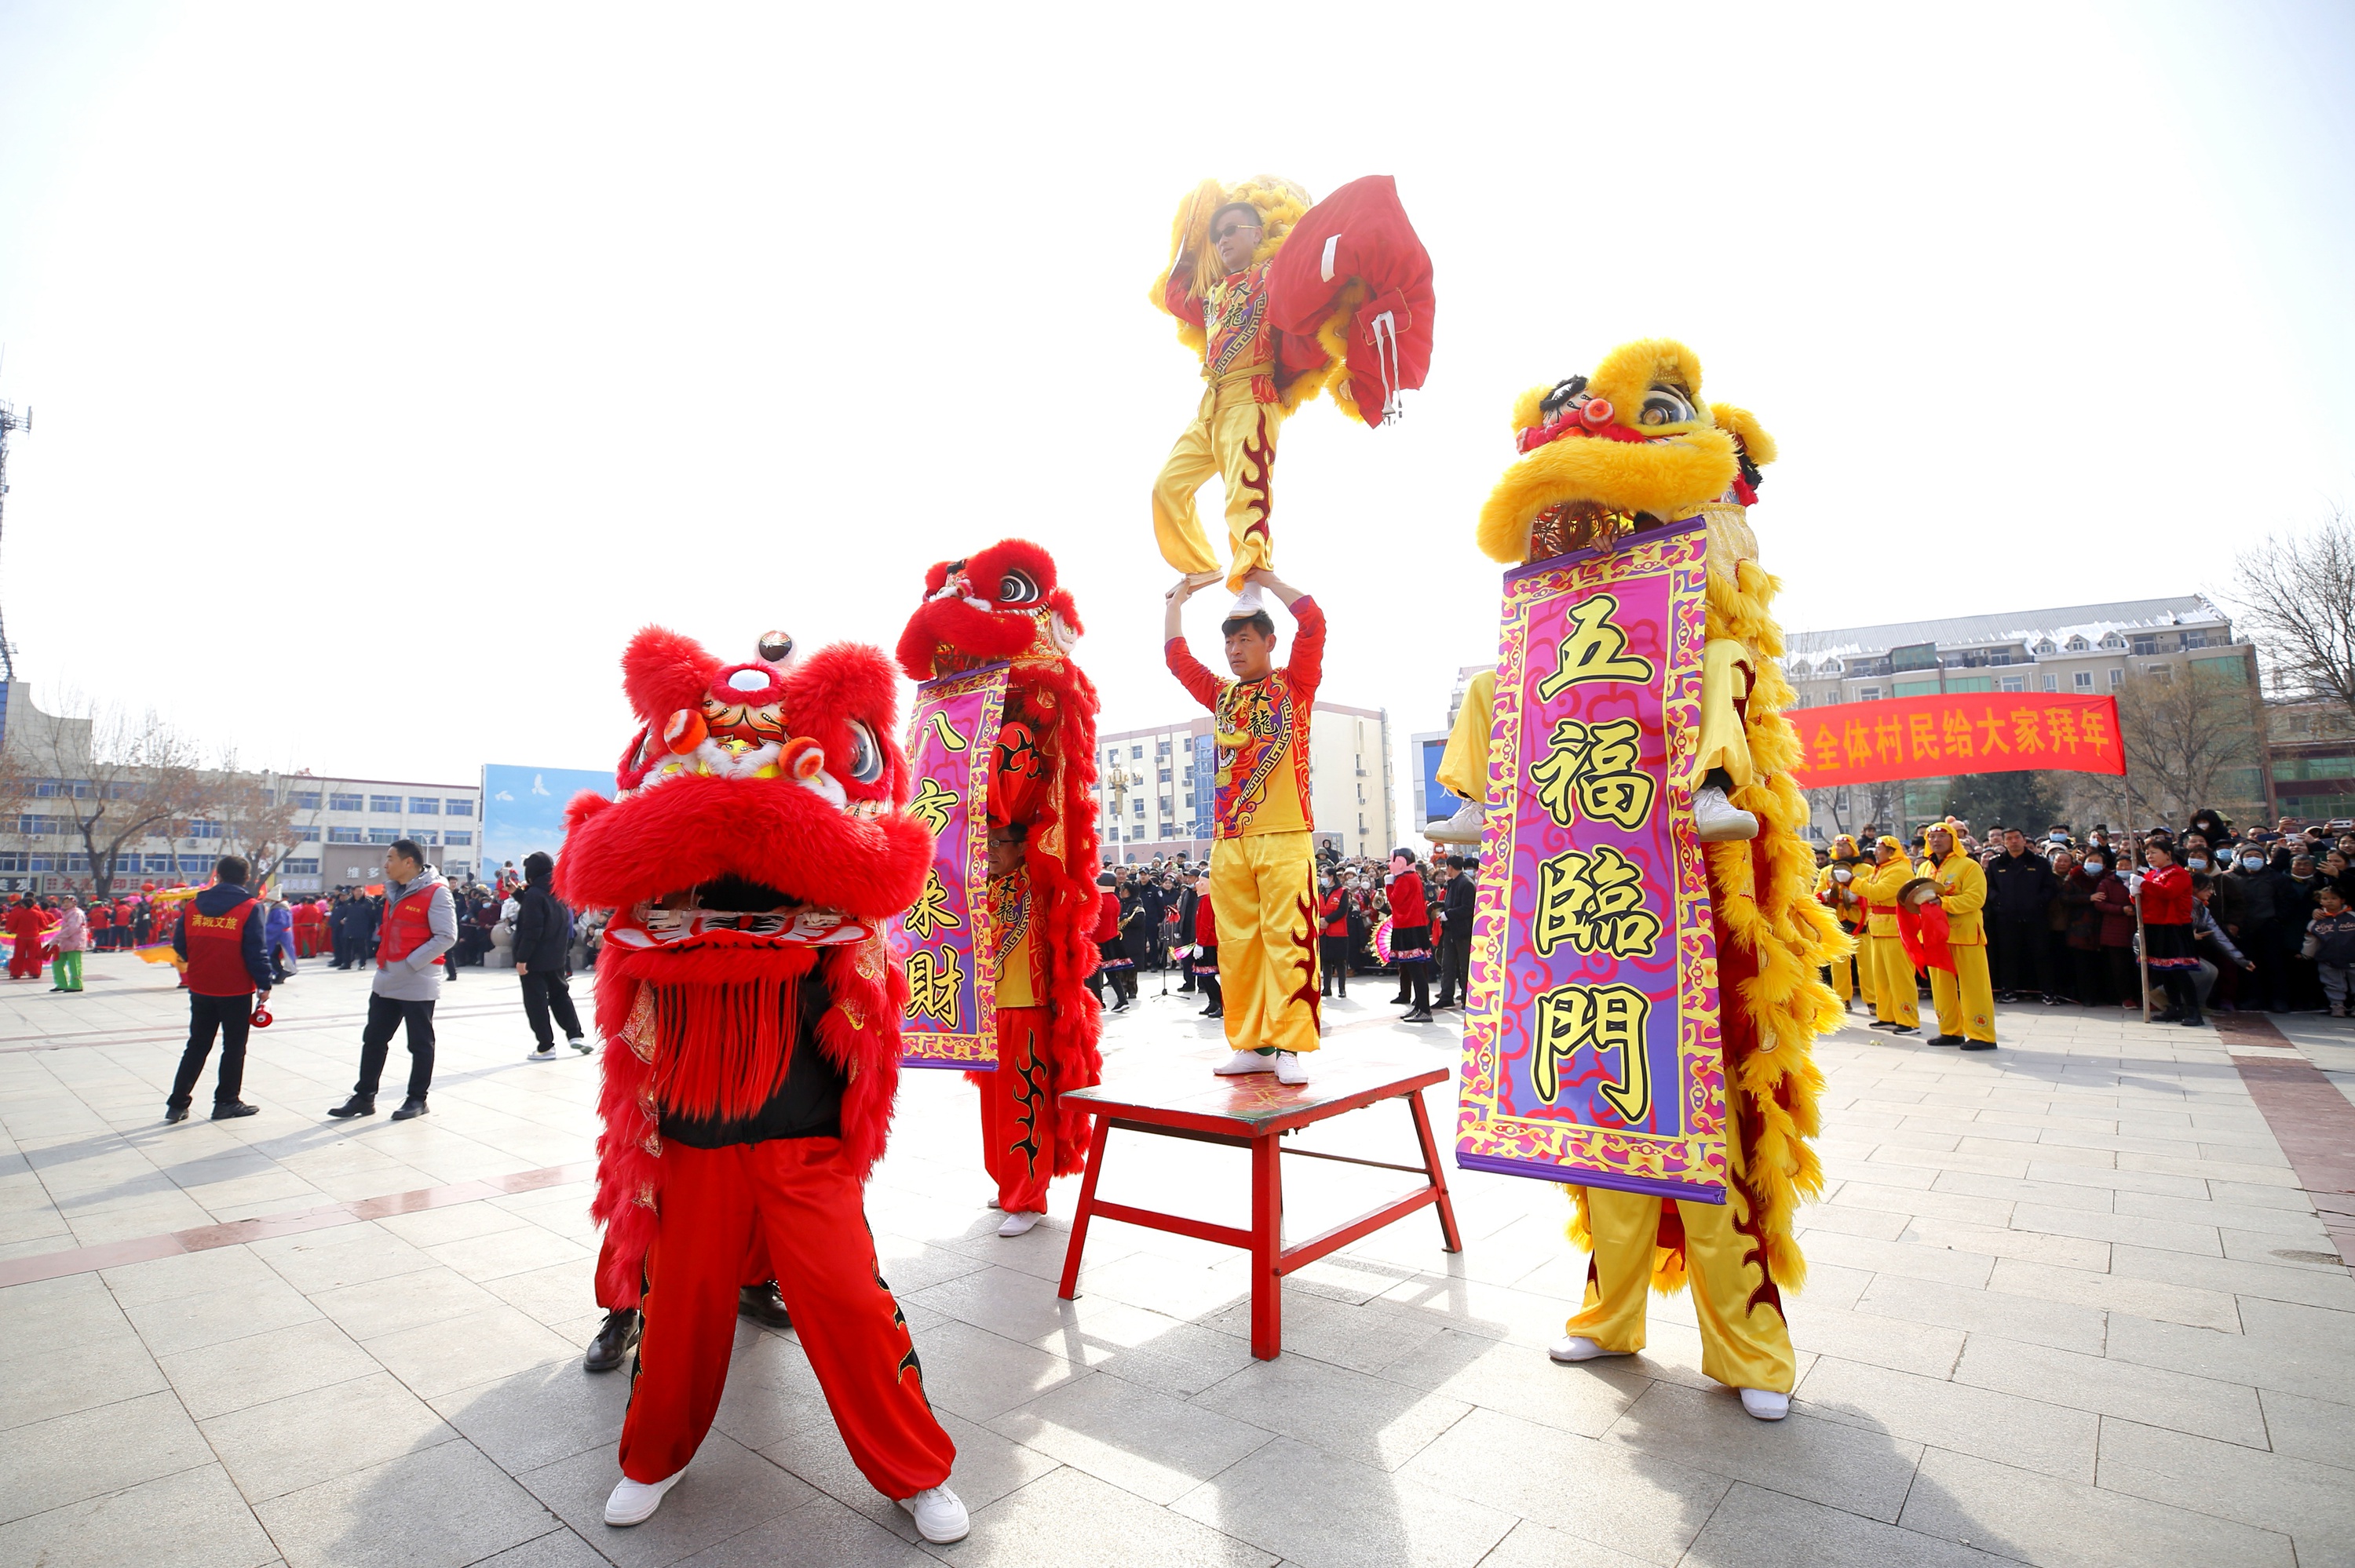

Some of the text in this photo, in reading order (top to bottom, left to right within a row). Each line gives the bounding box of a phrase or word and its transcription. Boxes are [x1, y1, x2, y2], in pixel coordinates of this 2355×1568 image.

[1531, 594, 1663, 1123] 五福臨門
[192, 913, 238, 930] 满城文旅
[996, 875, 1019, 924] 天龍
